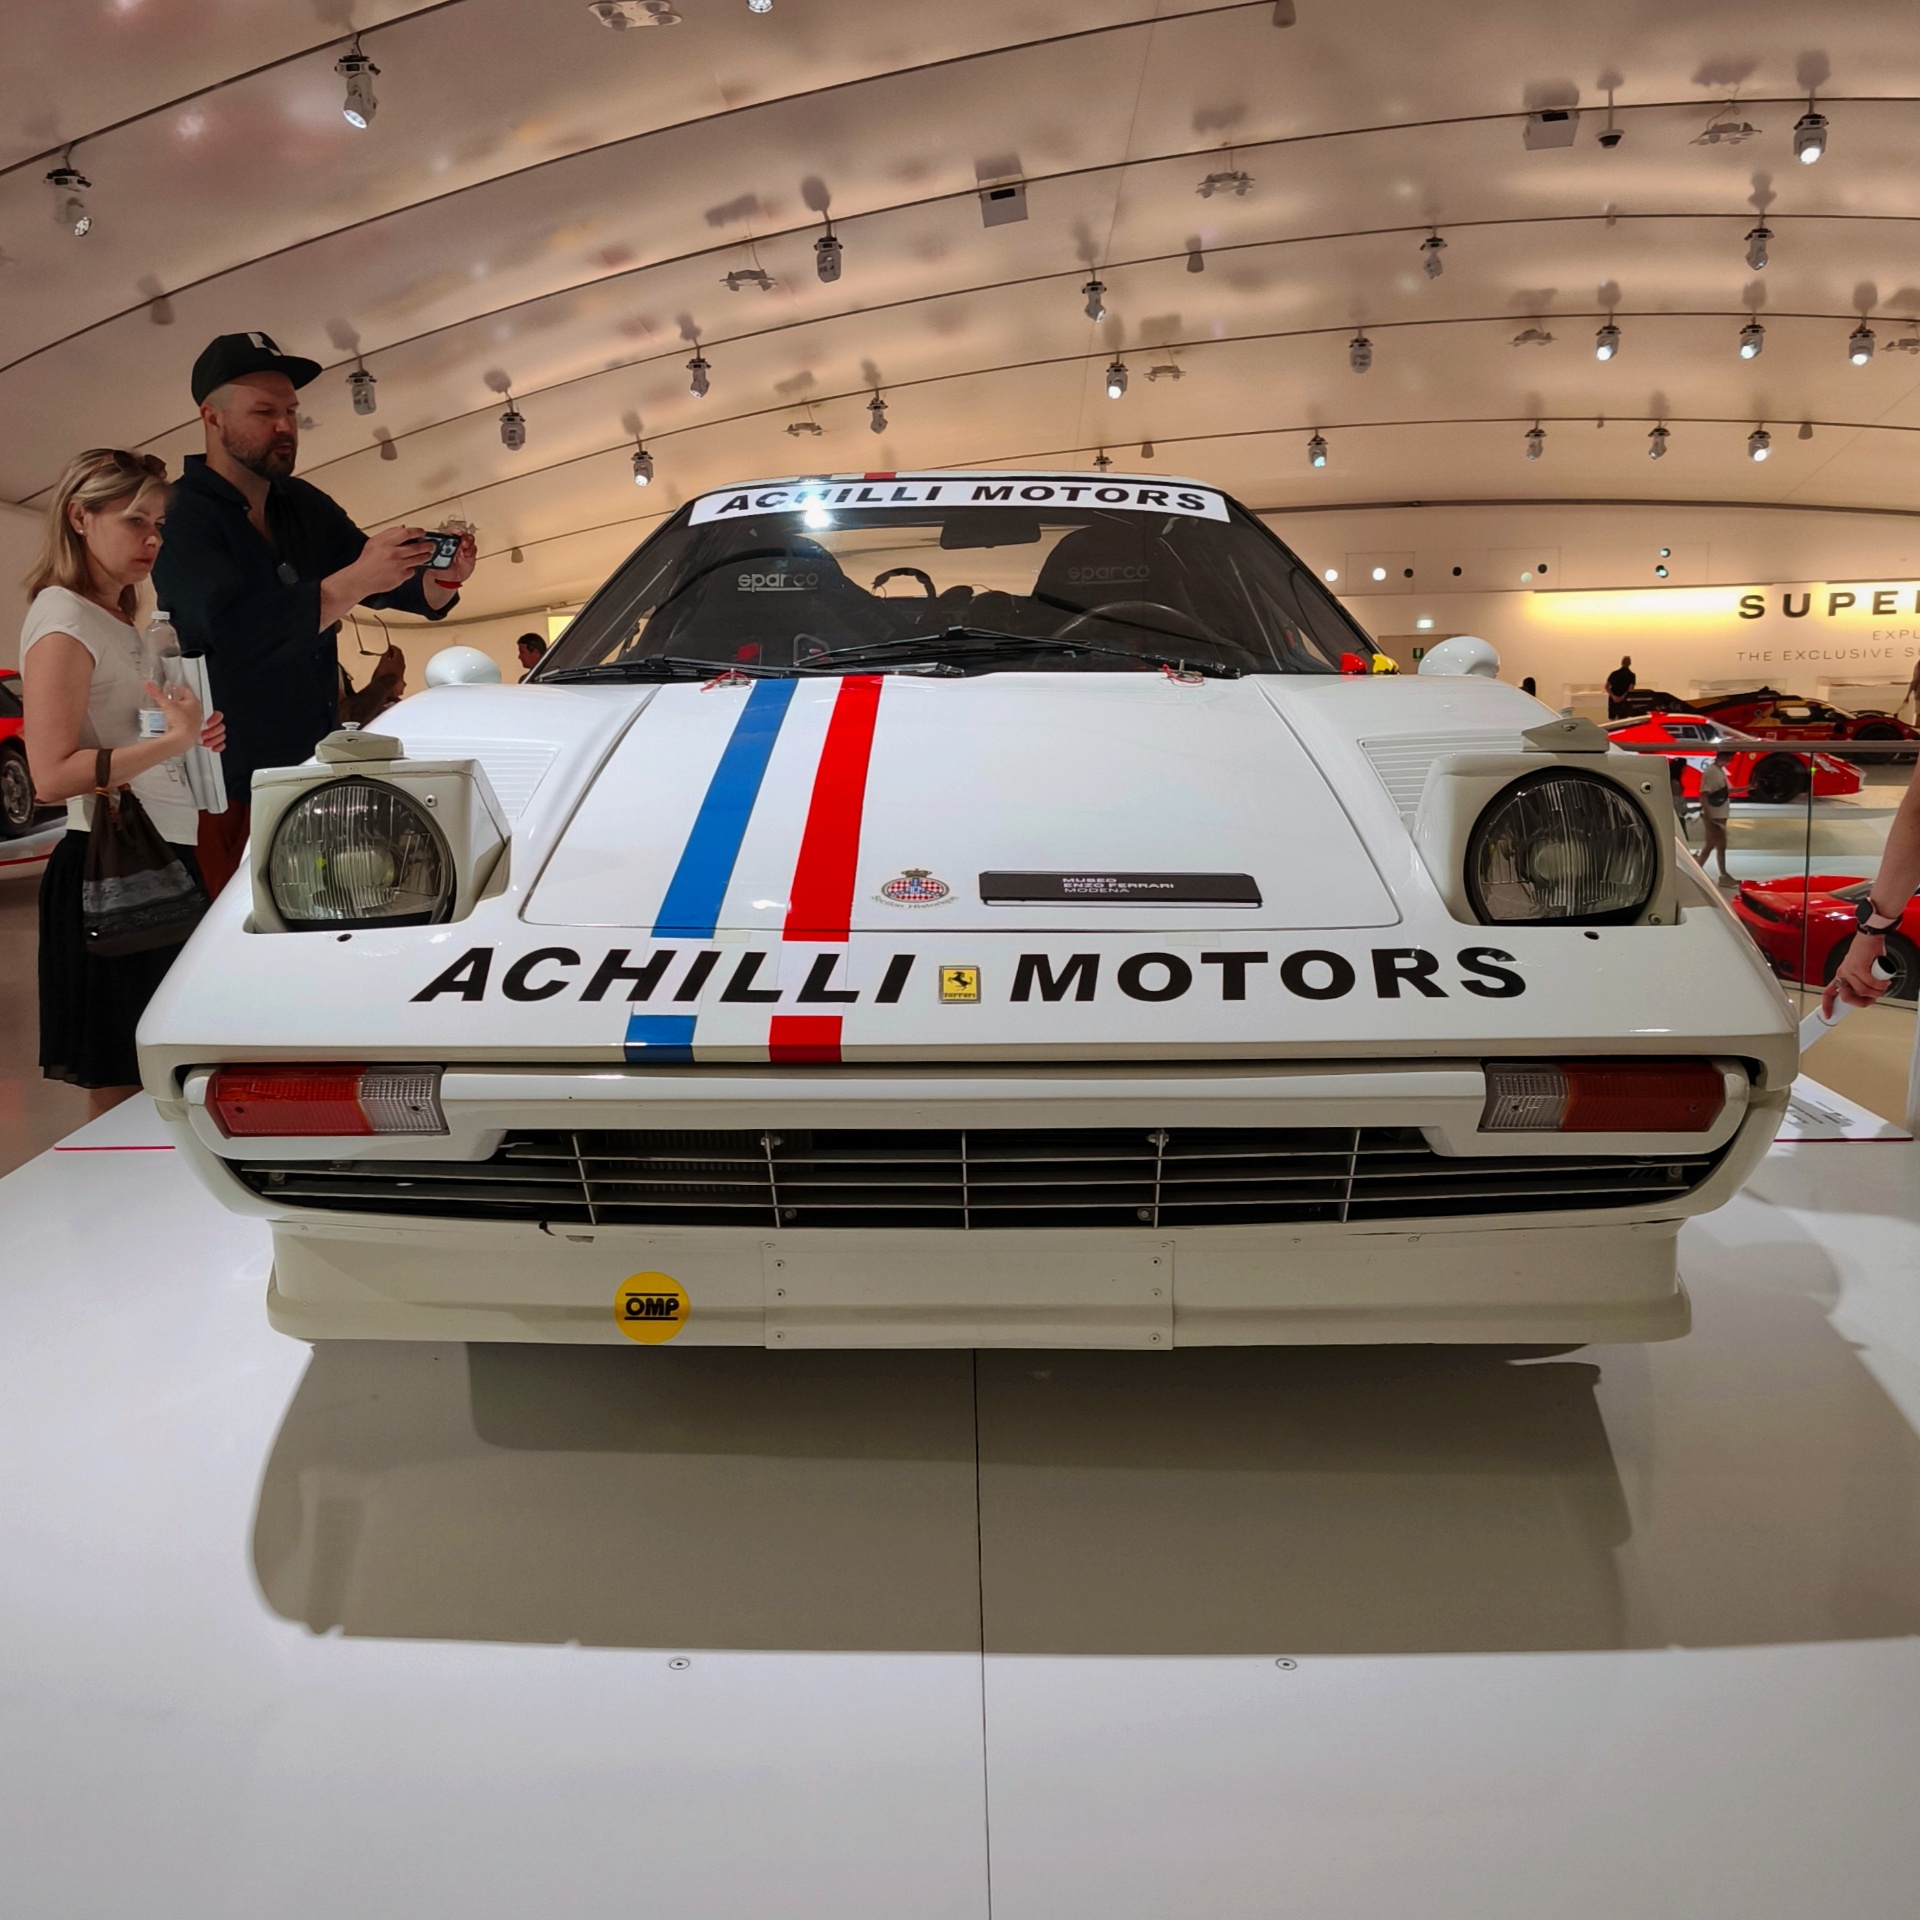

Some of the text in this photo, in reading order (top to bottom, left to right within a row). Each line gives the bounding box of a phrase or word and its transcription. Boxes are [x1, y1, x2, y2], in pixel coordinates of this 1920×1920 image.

[715, 485, 1206, 514] ACHILLI MOTORS
[737, 572, 819, 592] sparco
[1067, 564, 1150, 585] sparco
[1738, 589, 1920, 620] SUPE
[1736, 646, 1920, 662] THE EXCLUSIVE S
[411, 945, 917, 1004] ACHILLI
[1009, 946, 1527, 1002] MOTORS
[625, 1297, 680, 1316] OMP
